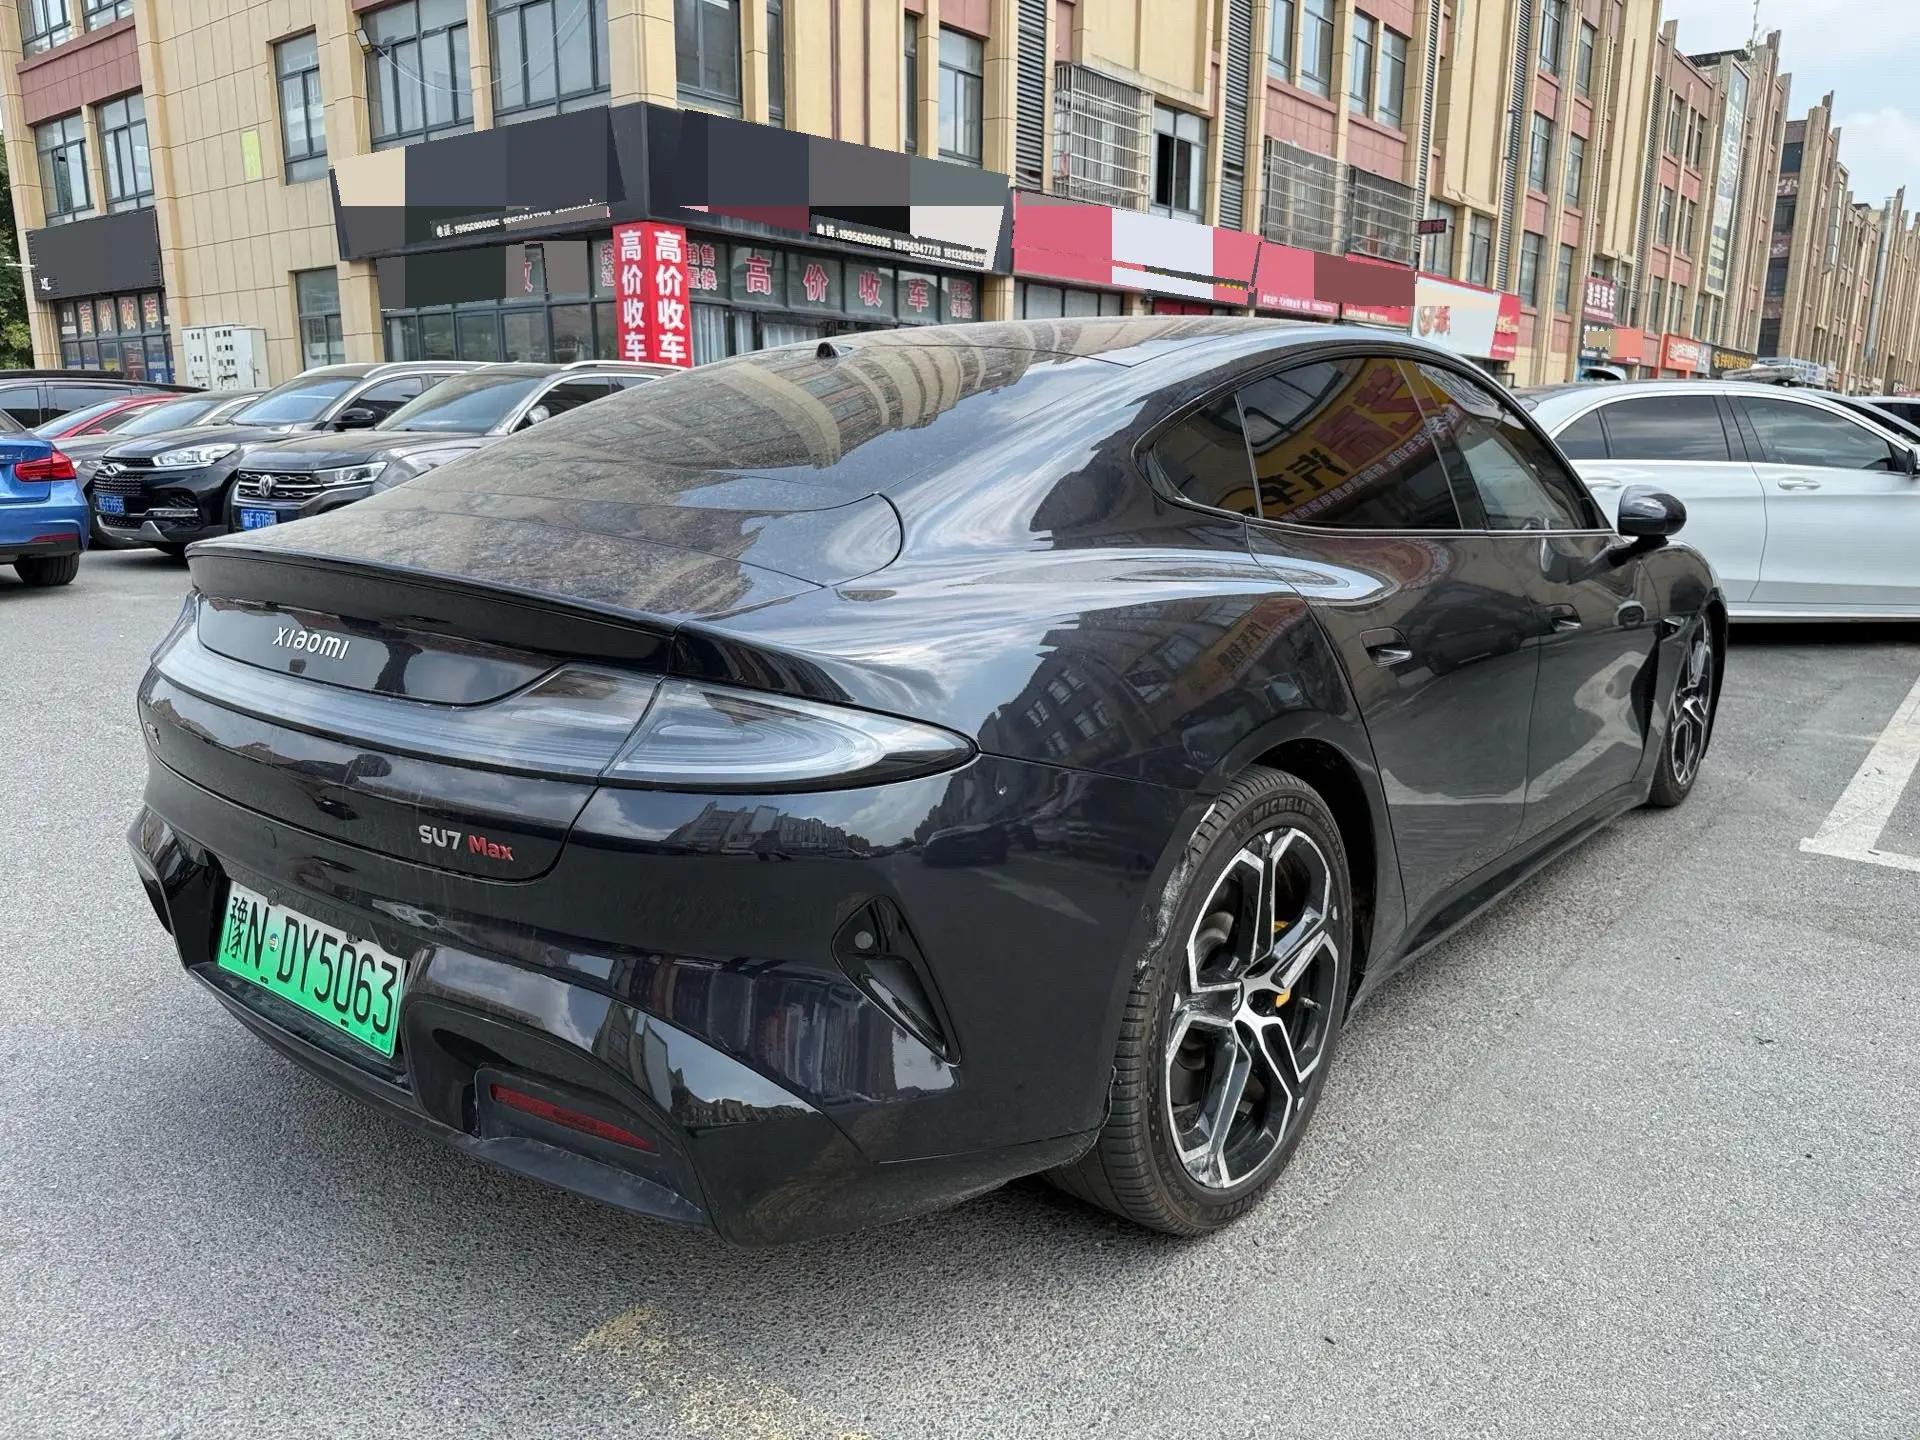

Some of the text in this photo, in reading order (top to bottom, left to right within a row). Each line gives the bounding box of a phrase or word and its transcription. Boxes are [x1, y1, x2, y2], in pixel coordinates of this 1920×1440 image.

[619, 229, 647, 362] 高价收车
[654, 230, 687, 364] 高价收车
[744, 255, 929, 313] 高价收车
[79, 297, 160, 335] 高价收车
[1252, 797, 1315, 822] MICHELIN
[418, 824, 514, 861] SU7 Max
